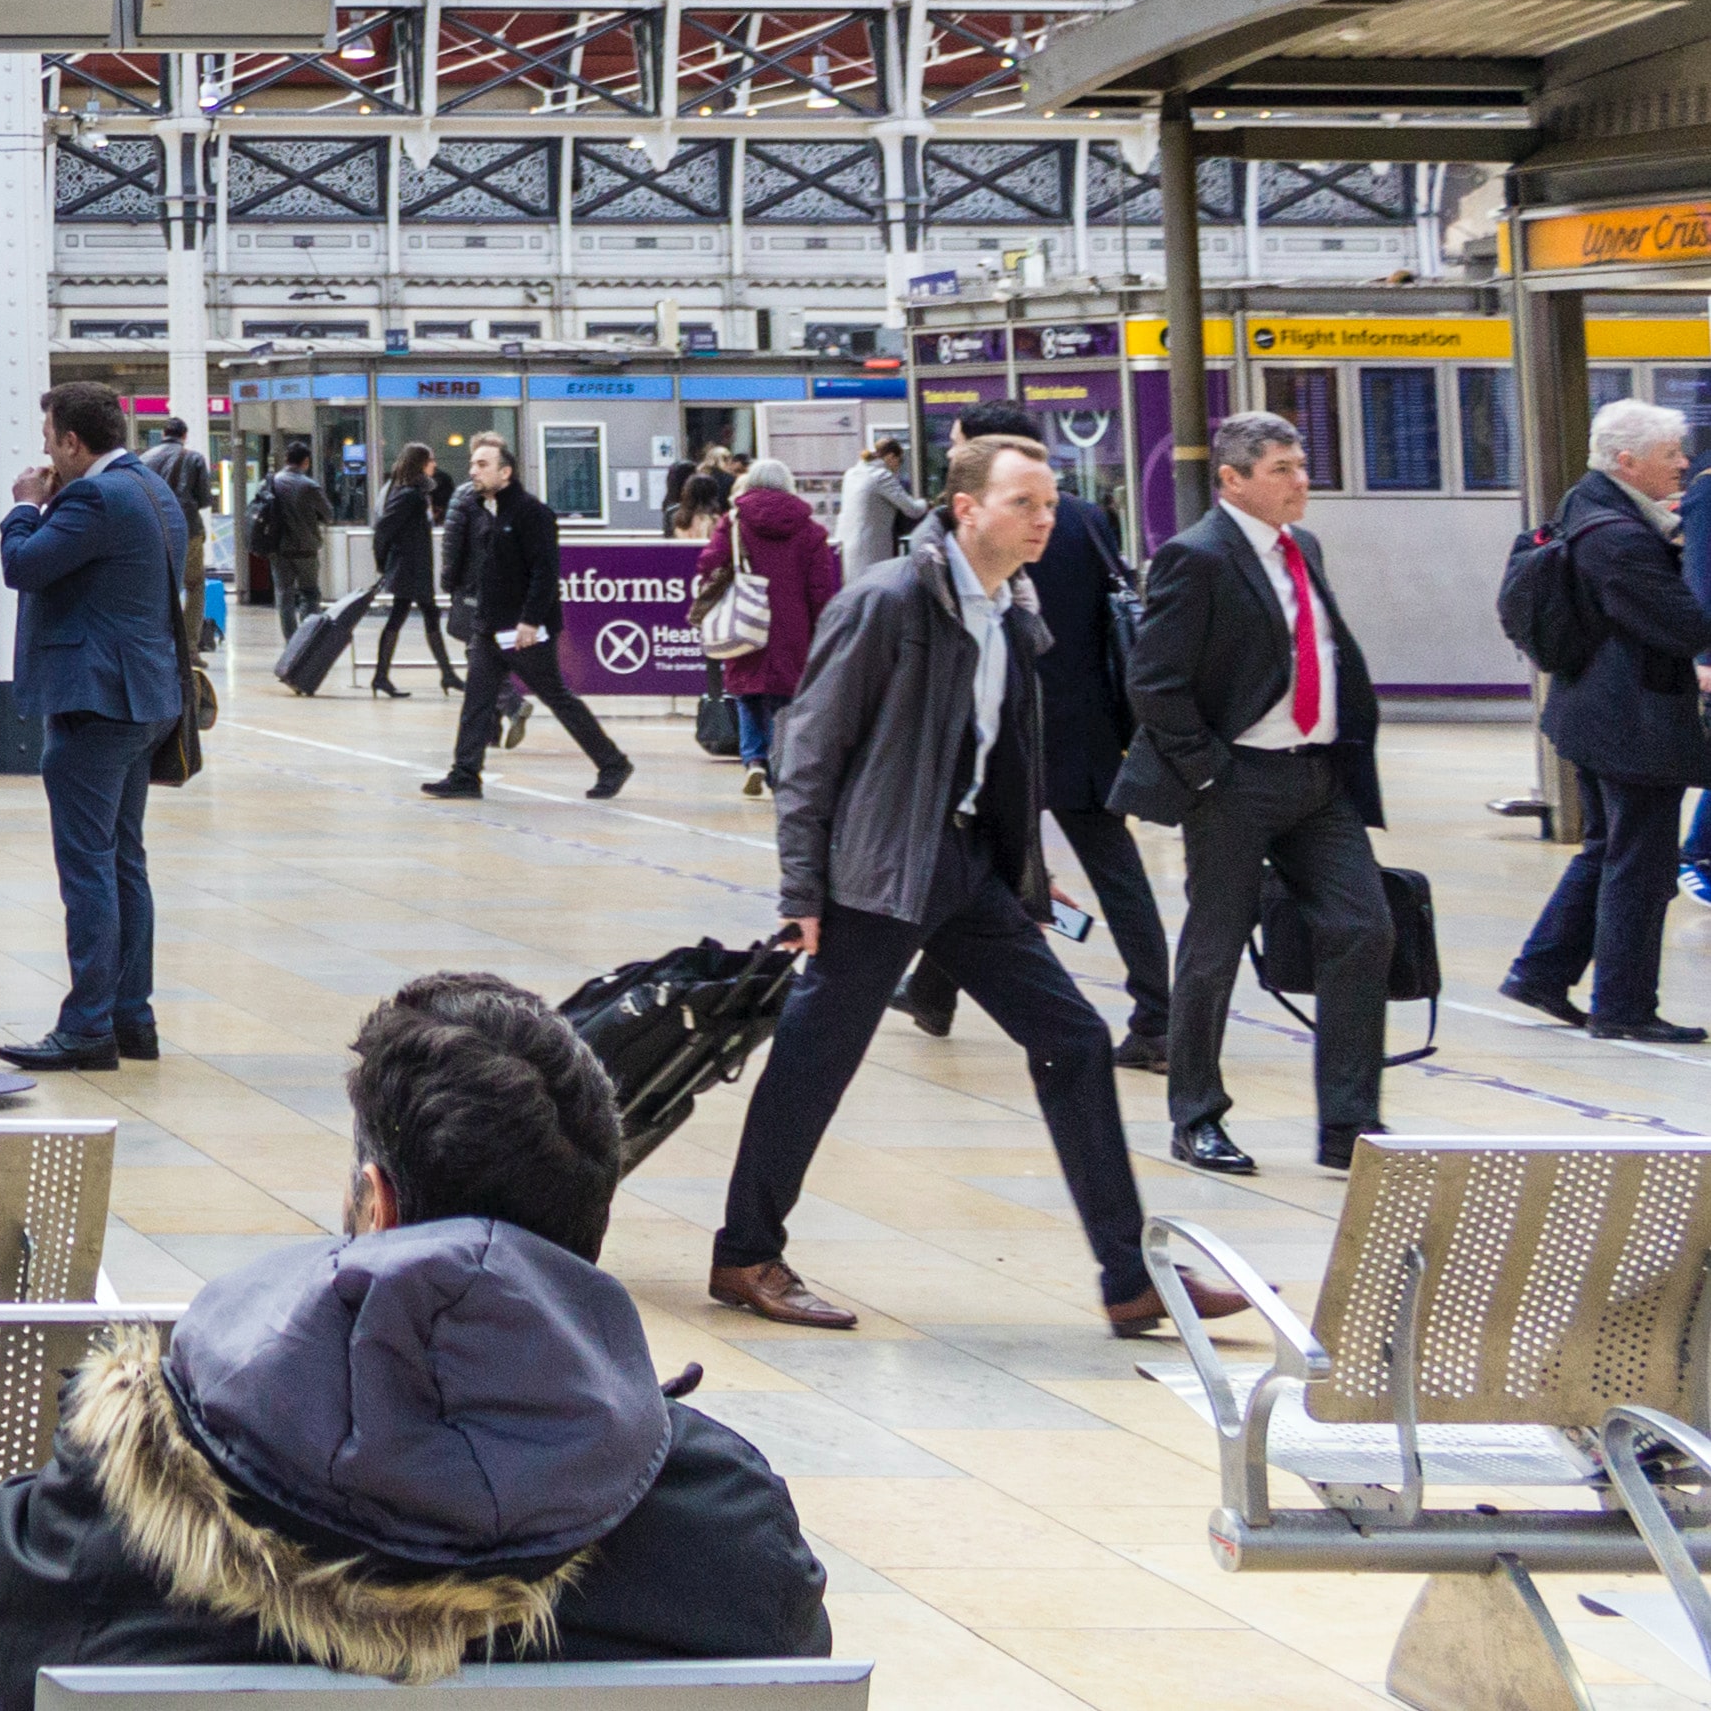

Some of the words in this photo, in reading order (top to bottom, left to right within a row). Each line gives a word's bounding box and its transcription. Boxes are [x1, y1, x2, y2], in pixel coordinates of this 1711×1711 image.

[1280, 330, 1336, 349] Flight
[1342, 330, 1461, 346] Information
[418, 381, 480, 395] NERO
[567, 382, 634, 394] EXPRESS
[652, 625, 701, 643] Heat
